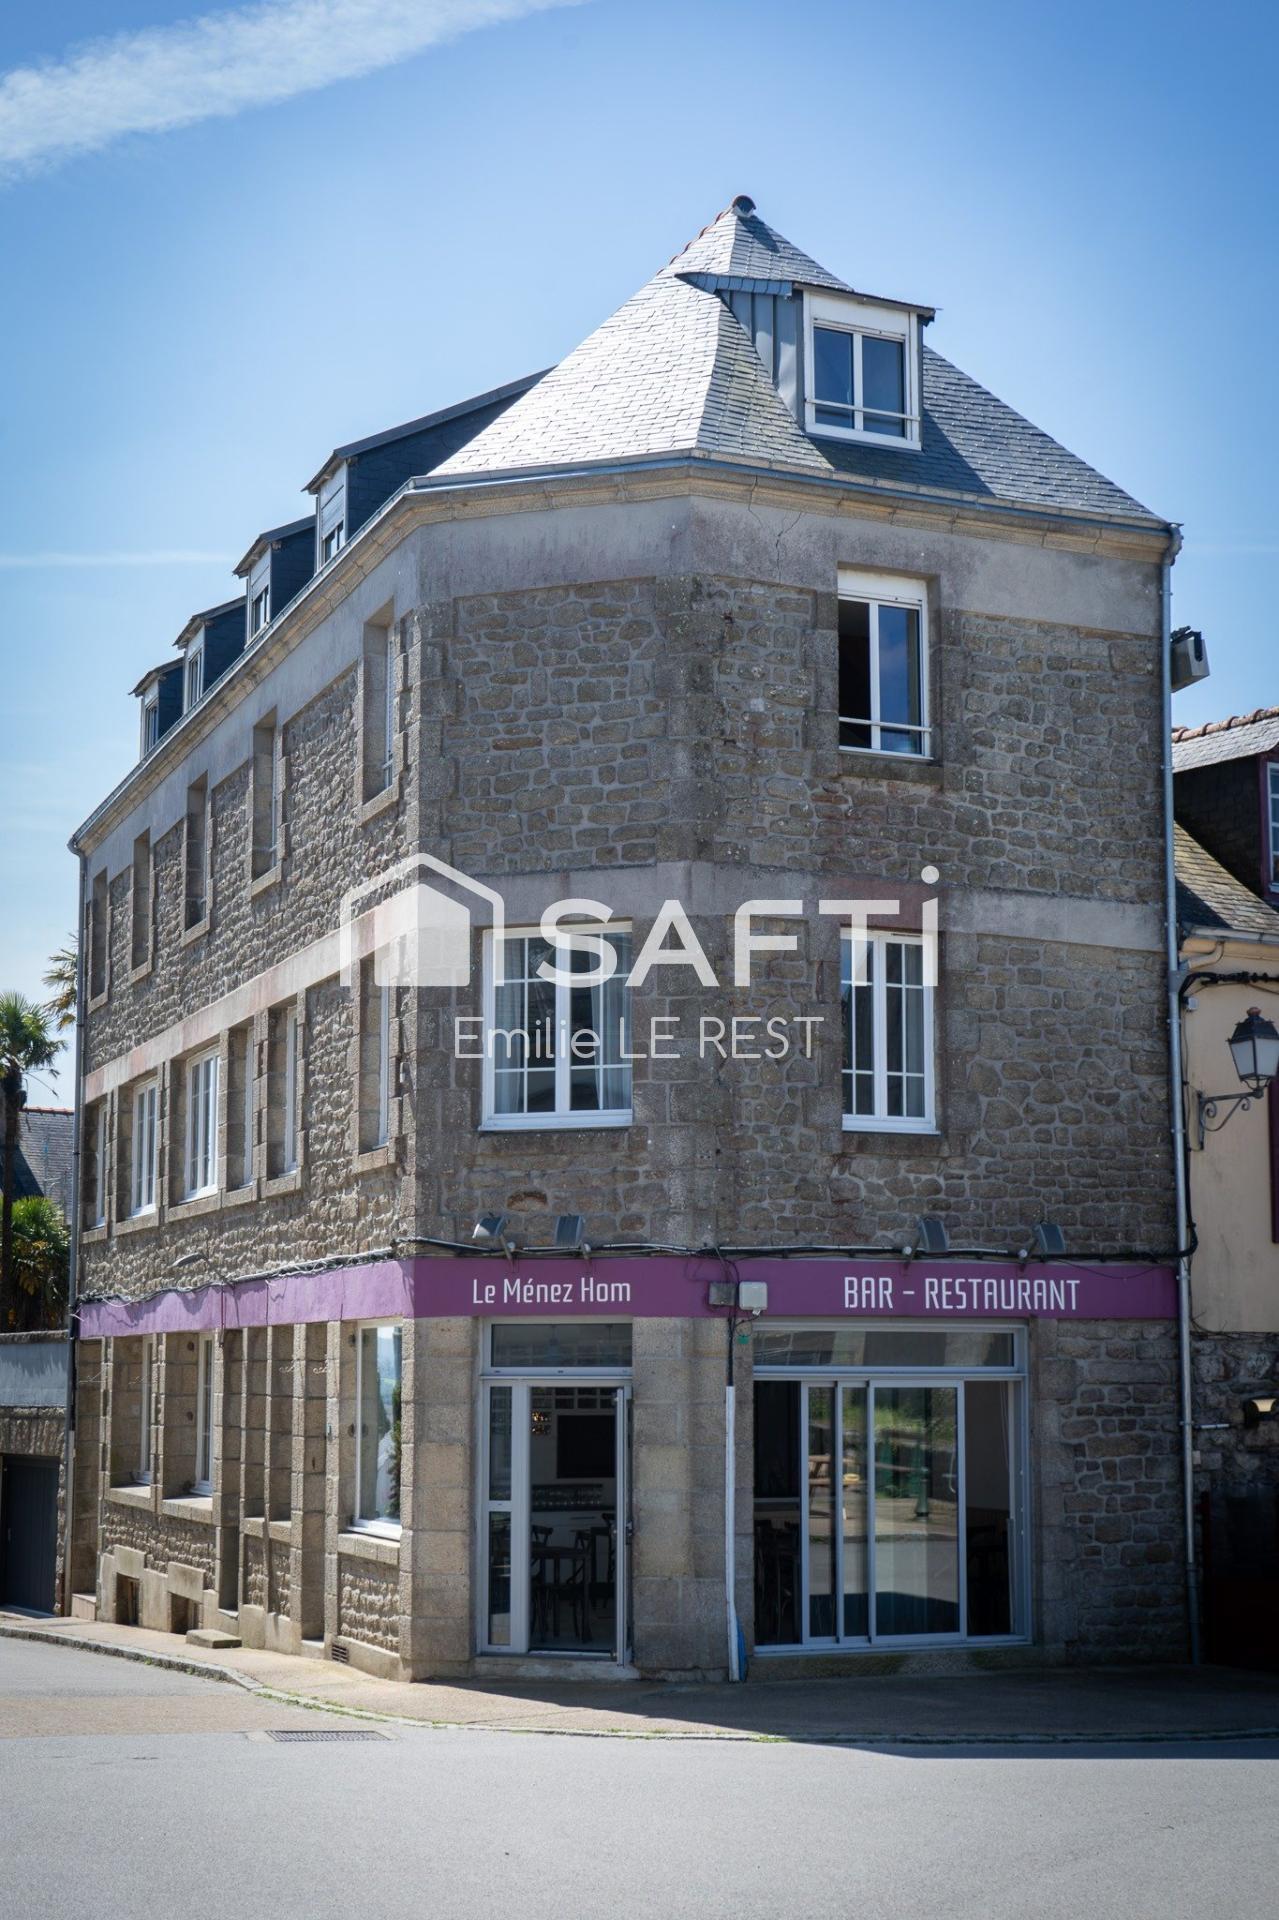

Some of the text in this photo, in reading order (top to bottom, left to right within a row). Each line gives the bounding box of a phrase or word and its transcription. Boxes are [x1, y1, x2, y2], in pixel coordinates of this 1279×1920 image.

[472, 1277, 631, 1304] Le Ménez Hom
[844, 1276, 894, 1309] BAR
[924, 1278, 1081, 1311] RESTAURANT
